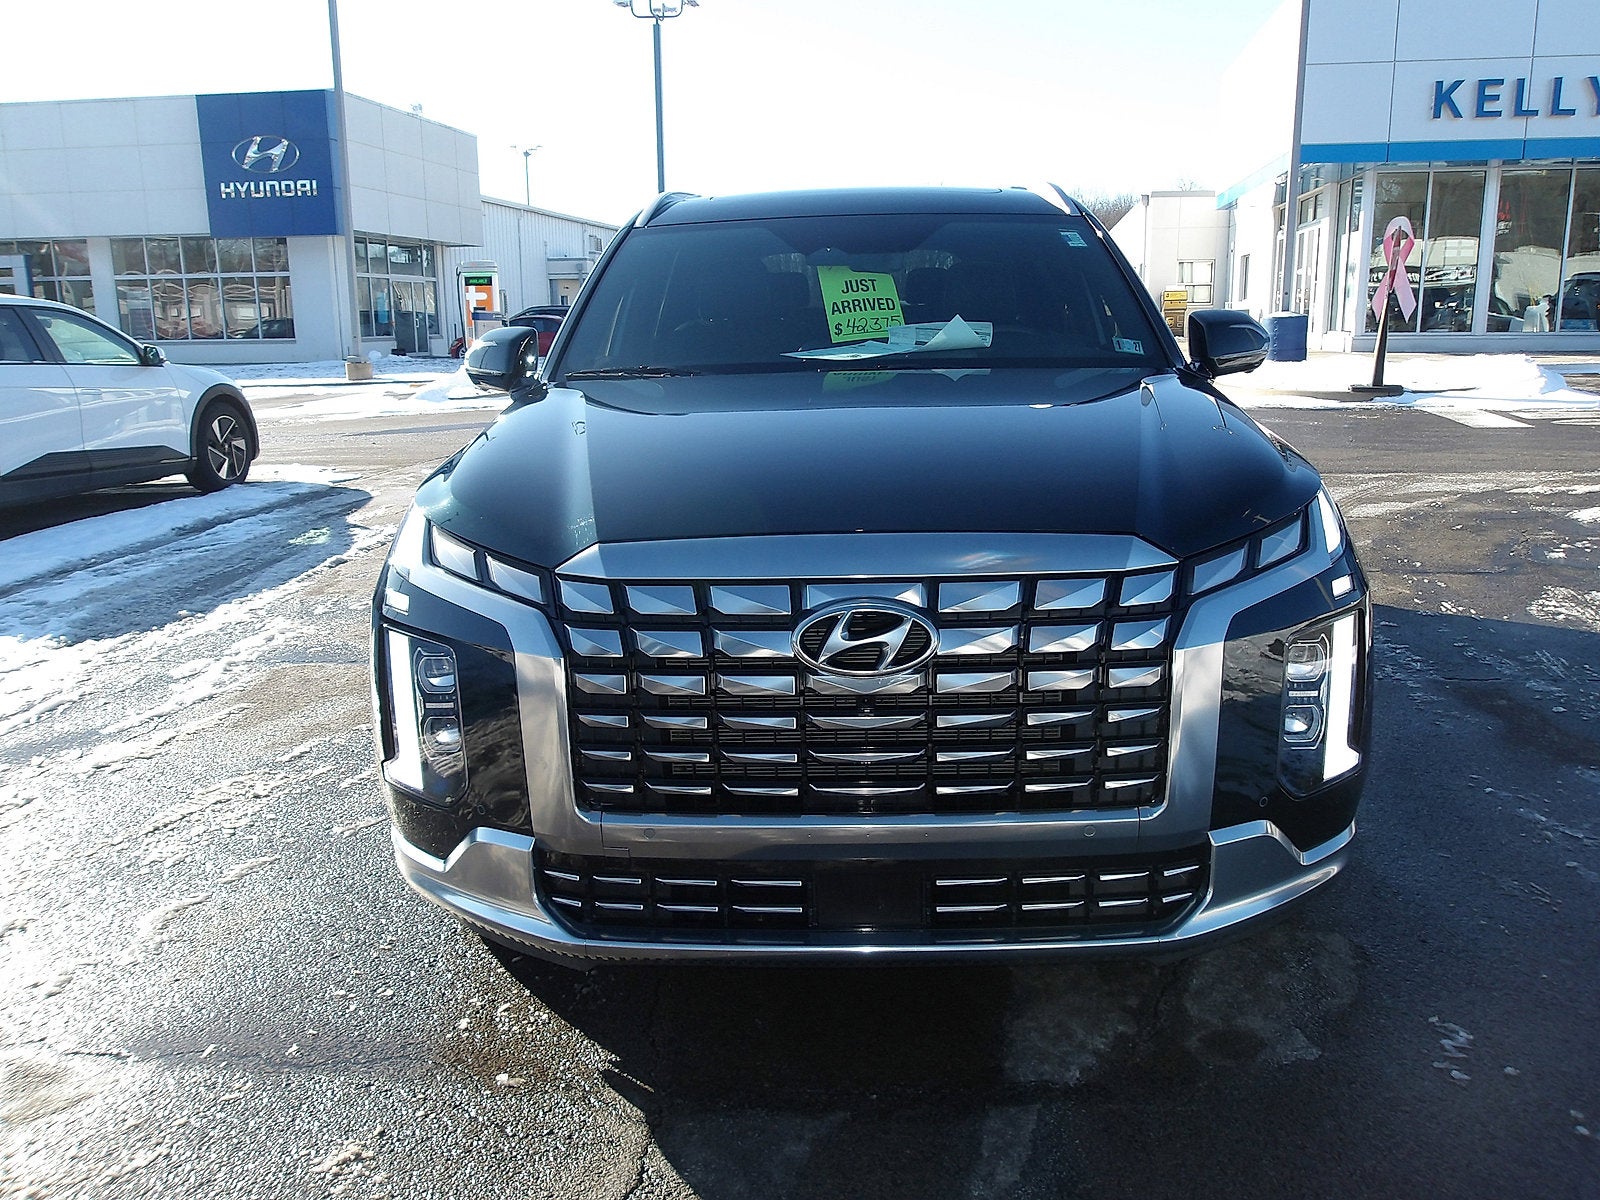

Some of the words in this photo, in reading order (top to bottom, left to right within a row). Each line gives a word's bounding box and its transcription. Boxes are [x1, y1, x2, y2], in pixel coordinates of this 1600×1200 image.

[220, 180, 318, 199] HYUNDAI
[841, 279, 877, 294] JUST
[831, 297, 896, 316] ARRIVED
